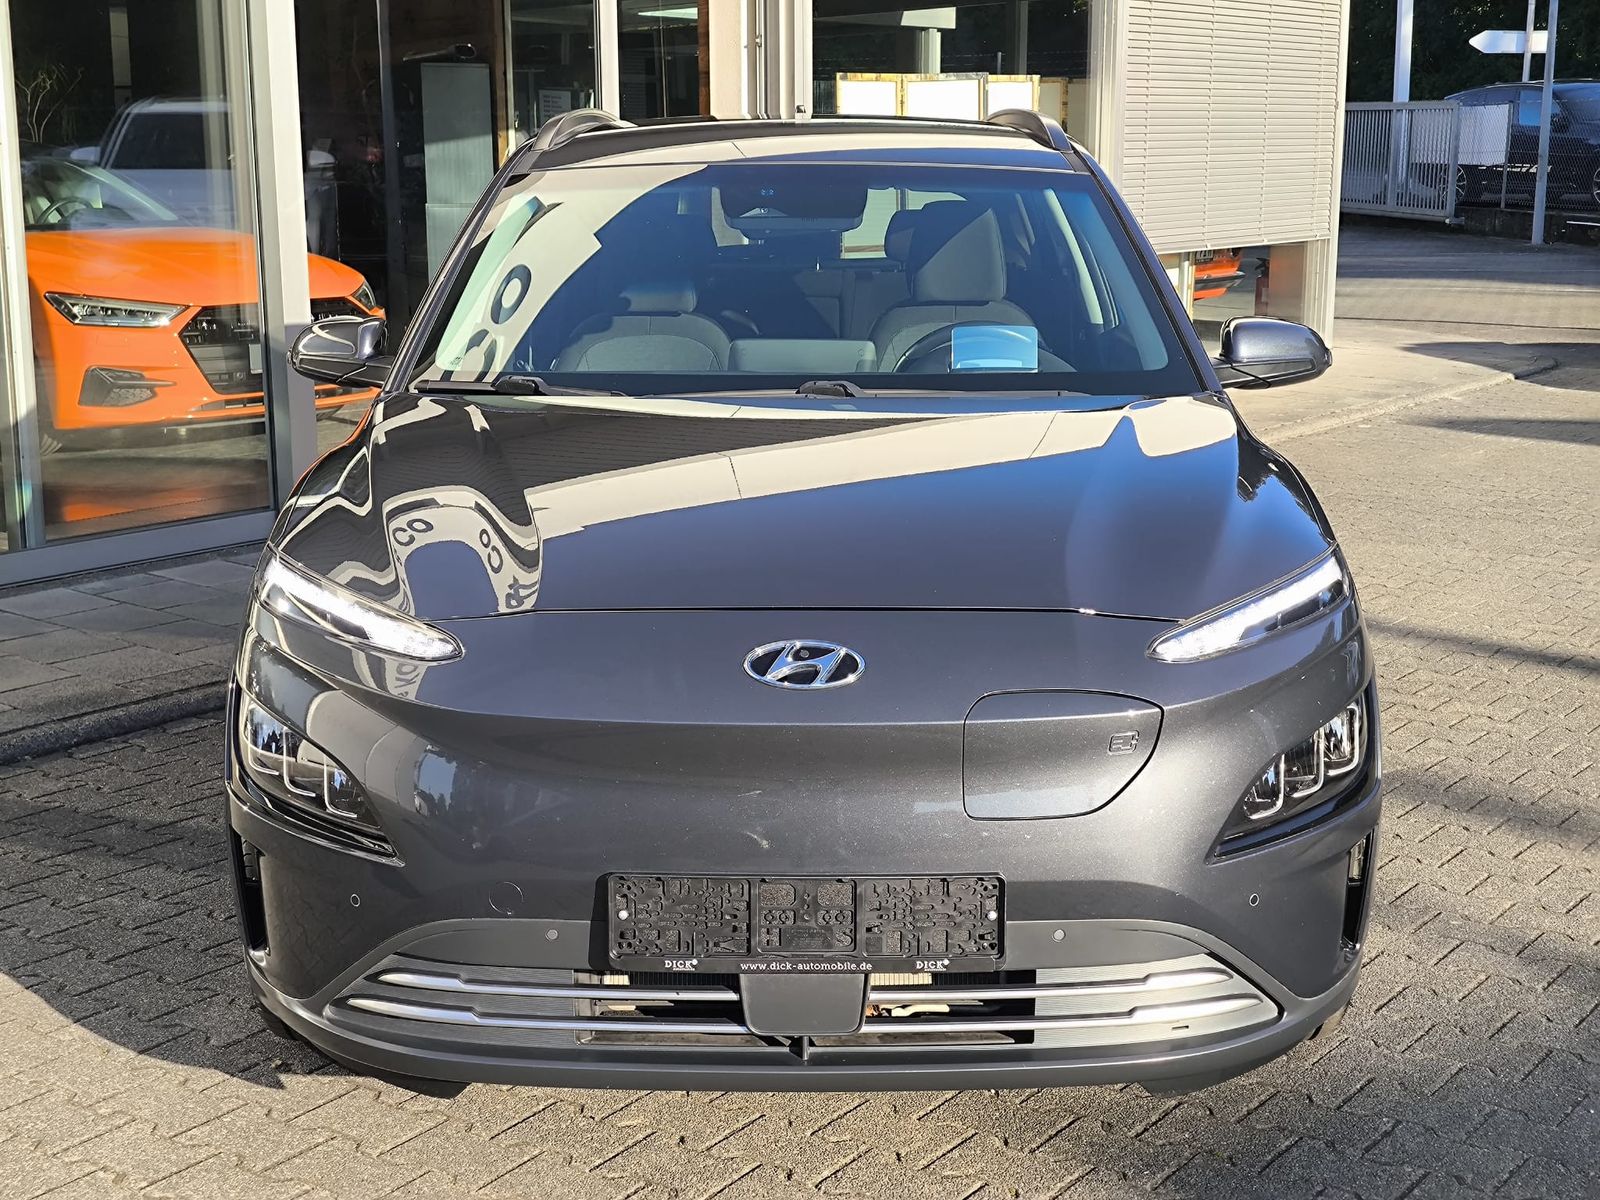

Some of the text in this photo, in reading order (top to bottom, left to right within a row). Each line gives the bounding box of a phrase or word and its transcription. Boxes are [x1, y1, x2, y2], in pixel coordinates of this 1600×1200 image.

[664, 960, 692, 969] DICK
[740, 961, 873, 971] www.dick-automobile.de
[915, 960, 943, 970] DICK
